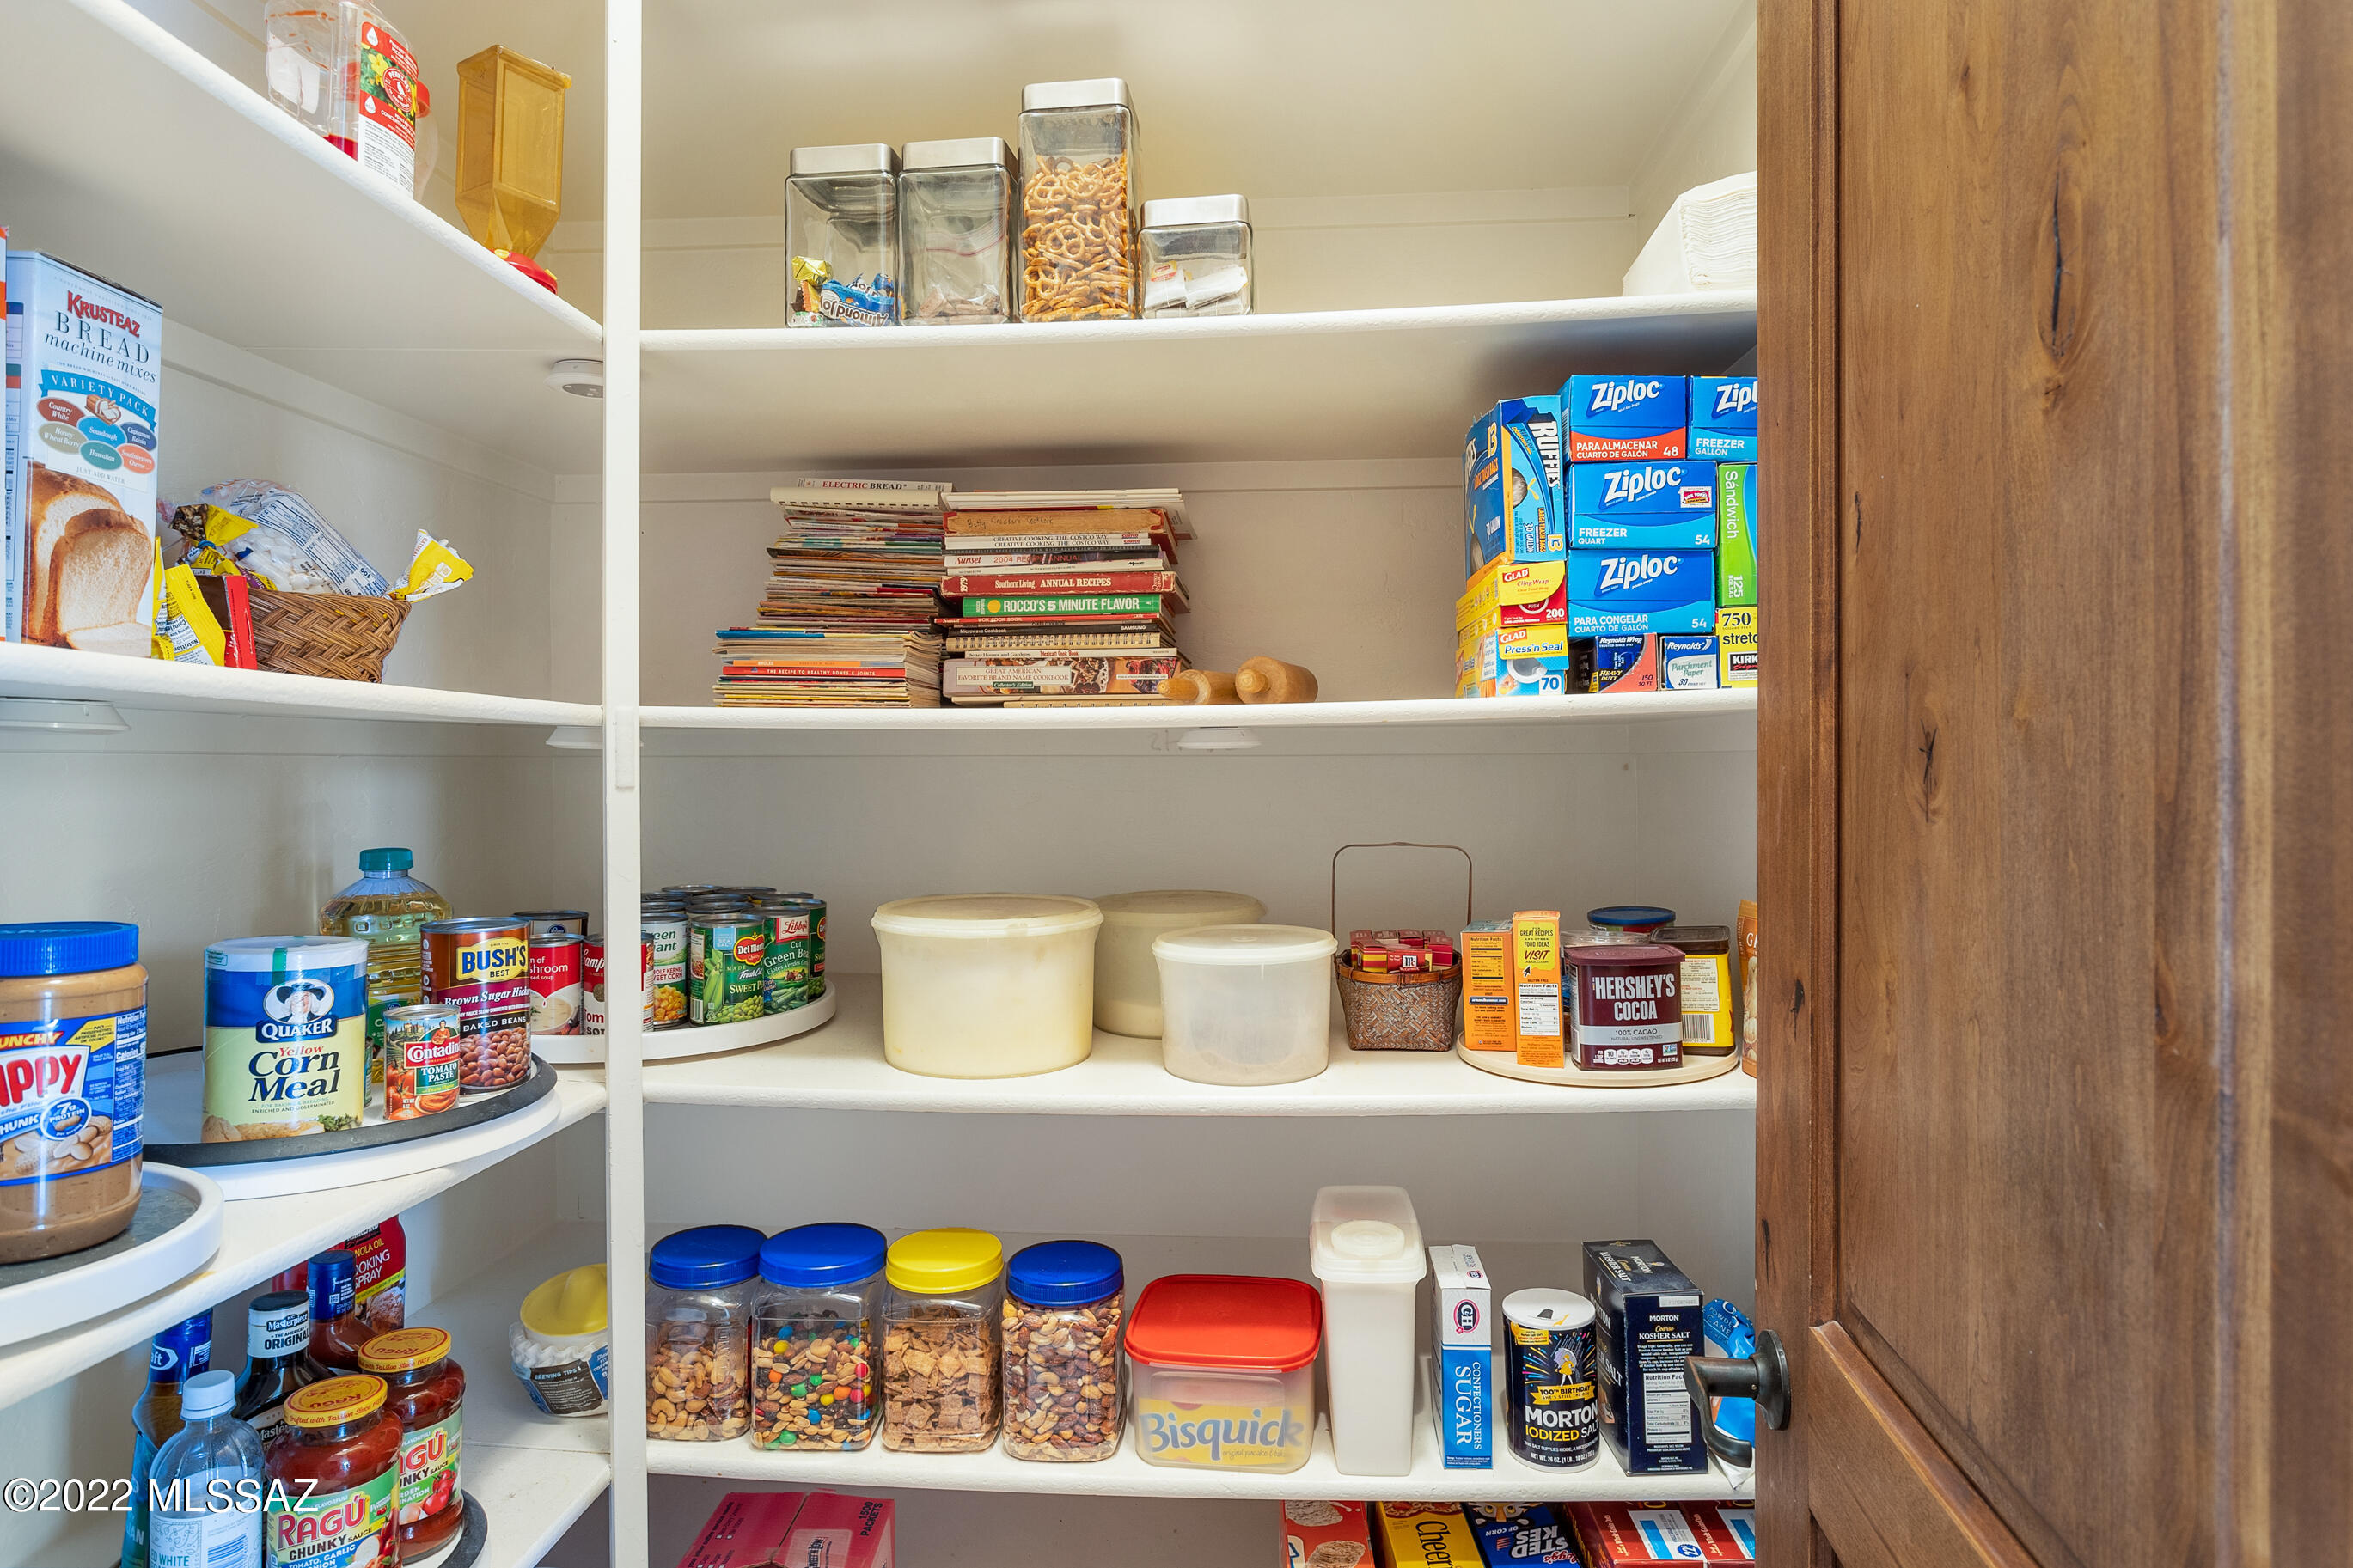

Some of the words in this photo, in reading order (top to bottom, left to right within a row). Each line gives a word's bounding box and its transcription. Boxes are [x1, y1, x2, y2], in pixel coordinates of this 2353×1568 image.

[67, 290, 142, 339] KRUSTEAZ
[55, 309, 150, 363] BREAD
[45, 333, 114, 367] machine
[117, 358, 156, 384] mixes
[51, 375, 114, 397] VARIETY
[119, 392, 149, 418] PACK
[1592, 379, 1660, 412] Ziploc
[1576, 441, 1599, 452] PARA
[1600, 440, 1658, 451] ALMACENAR
[1695, 447, 1728, 455] GALLON
[1696, 438, 1745, 449] FREEZER
[1576, 450, 1608, 459] CUARTO
[1621, 448, 1648, 458] GALÓN
[1663, 446, 1679, 457] 48
[822, 480, 868, 490] ELECTRIC
[1604, 467, 1682, 503] Ziploc
[1725, 470, 1739, 539] Sándwich
[1579, 527, 1628, 538] FREEZER
[1695, 534, 1711, 546] 54
[1526, 533, 1535, 553] GALLON
[1548, 534, 1564, 552] 13
[955, 556, 981, 565] Sunset
[1504, 568, 1529, 583] GLAD
[1599, 555, 1678, 590] Ziploc
[959, 577, 969, 593] 1979
[994, 579, 1018, 589] Southern
[1018, 580, 1036, 590] Living
[1040, 578, 1075, 588] ANNUAL
[1076, 577, 1112, 587] RECIPES
[1533, 578, 1549, 587] Wrap
[1733, 574, 1744, 598] 125
[1003, 599, 1046, 613] ROCCO'S
[1048, 601, 1056, 612] 5
[1058, 598, 1098, 612] MINUTE
[1101, 597, 1140, 611] FLAVOR
[1545, 608, 1565, 619] 200
[1574, 616, 1593, 626] PARA
[1595, 614, 1648, 625] CONGELAR
[1721, 612, 1751, 627] 750
[1574, 625, 1605, 634] CUARTO
[1607, 625, 1620, 633] DE
[1621, 622, 1649, 632] GALÓN
[1691, 618, 1708, 629] 54
[1500, 630, 1526, 644] GLAD
[1599, 637, 1626, 645] Reynolds
[1626, 636, 1642, 644] Wrap
[1505, 644, 1540, 655] Press'n
[1541, 642, 1563, 651] Seal
[1667, 642, 1702, 651] Reynolds
[1599, 669, 1623, 678] HEAVY
[1672, 659, 1713, 673] Parchment
[1683, 668, 1704, 677] Paper
[1541, 677, 1560, 690] 70
[737, 943, 750, 955] Del
[1524, 949, 1551, 961] VISIT
[461, 945, 526, 975] BUSH'S
[763, 952, 796, 967] Green
[489, 969, 510, 978] BEST
[730, 983, 756, 994] SWEET
[1595, 973, 1675, 1000] HERSHEY'S
[445, 997, 479, 1006] Brown
[480, 991, 511, 1002] Sugar
[1614, 1000, 1658, 1021] COCOA
[261, 1017, 333, 1040] QUAKER
[462, 1020, 498, 1032] BAKED
[501, 1016, 527, 1026] BEANS
[279, 1046, 324, 1057] Yellow
[248, 1051, 339, 1077] Corn
[421, 1062, 457, 1076] TOMATO
[248, 1068, 340, 1101] Meal
[428, 1071, 454, 1083] PASTE
[49, 1107, 86, 1123] PROTEIN
[373, 1238, 385, 1249] OIL
[268, 1312, 308, 1331] Masterpiece
[1707, 1313, 1733, 1336] CANE
[264, 1327, 309, 1350] ORIGINAL
[1639, 1332, 1671, 1340] KOSHER
[1560, 1385, 1591, 1394] BIRTHDAY
[1454, 1365, 1473, 1445] SUGAR
[1472, 1361, 1482, 1450] CONFECTIONERS
[1524, 1400, 1599, 1428] MORTON
[1140, 1407, 1305, 1461] Bisquick
[1525, 1425, 1580, 1442] IODIZED
[1580, 1420, 1599, 1438] SALT
[430, 1461, 449, 1475] SAUCE
[858, 1501, 874, 1520] 1500
[278, 1493, 368, 1550] RAGÚ
[860, 1502, 883, 1537] PACKETS
[1485, 1528, 1507, 1536] CORN
[289, 1534, 347, 1562] CHUNKY
[347, 1528, 373, 1544] SAUCE
[323, 1544, 357, 1562] GARLIC
[159, 1555, 190, 1567] WHITE
